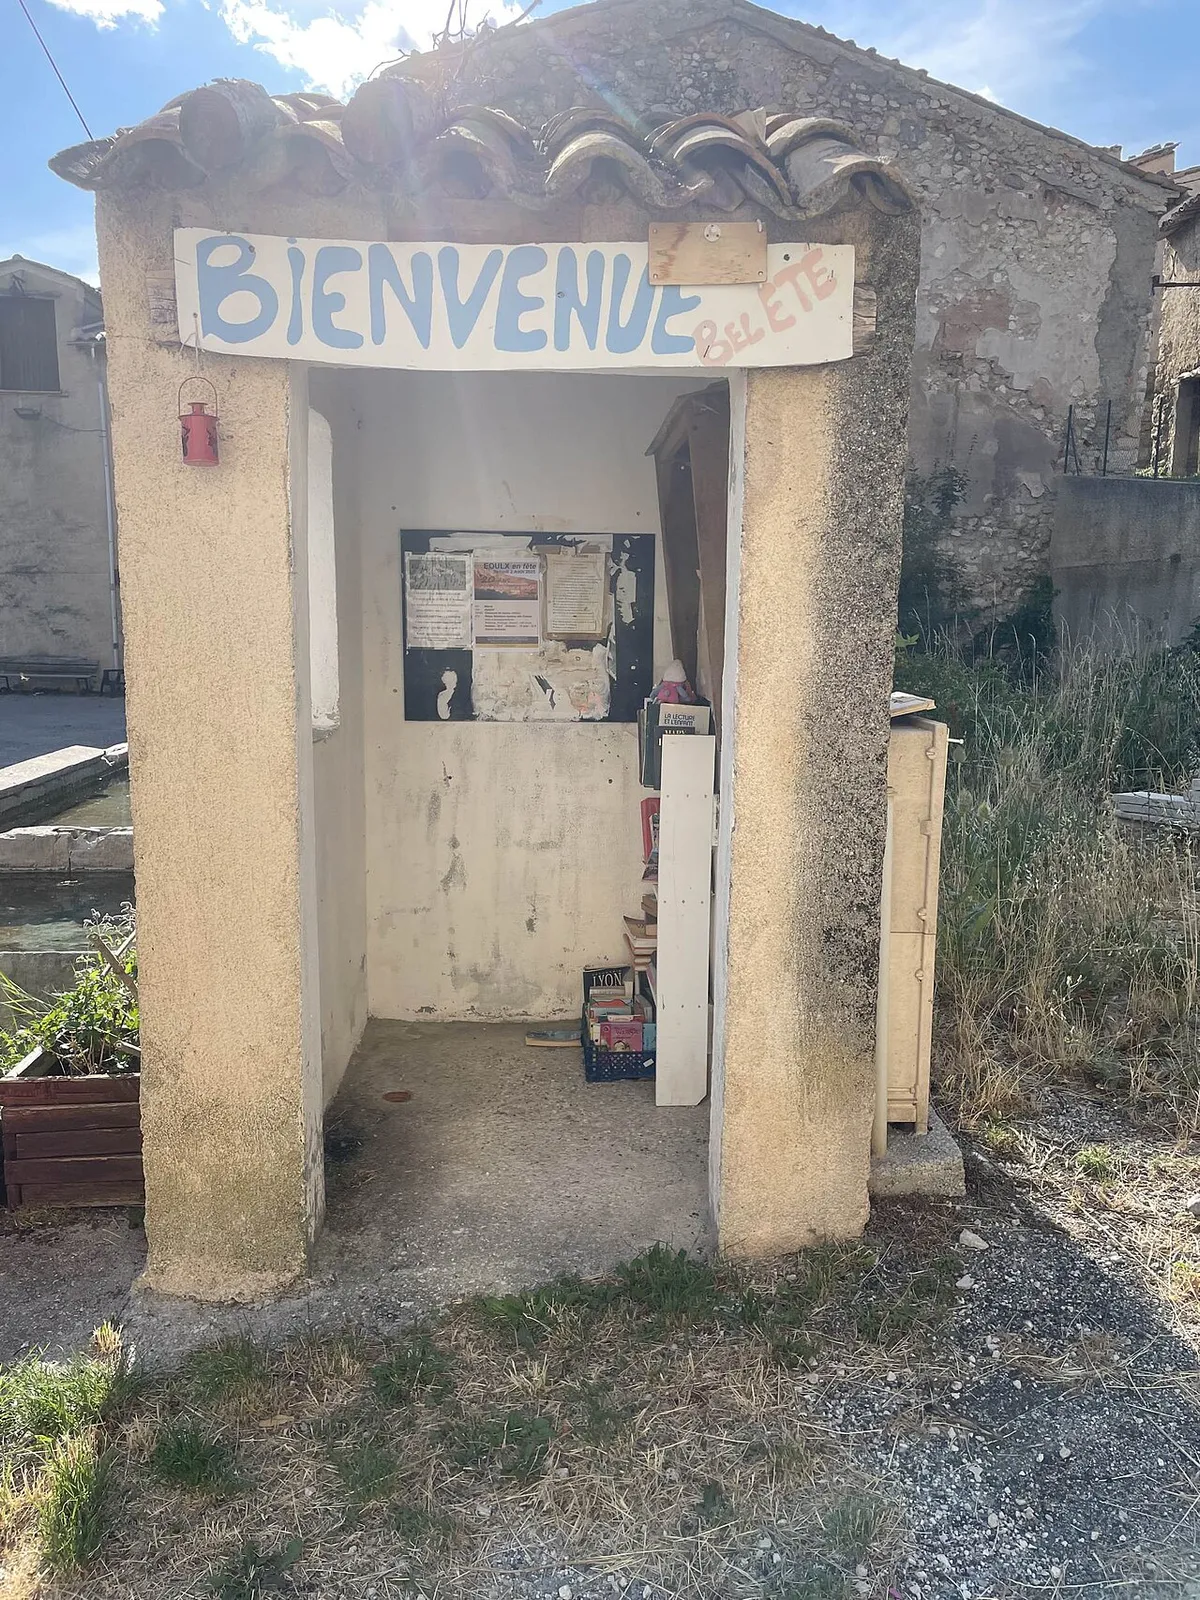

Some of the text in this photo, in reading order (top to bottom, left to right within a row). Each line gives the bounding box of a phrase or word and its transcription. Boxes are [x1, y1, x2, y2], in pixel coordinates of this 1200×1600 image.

[692, 312, 765, 366] BEL
[483, 562, 510, 570] EOULX
[522, 562, 537, 570] fête
[672, 713, 695, 722] LECTURE
[593, 972, 622, 987] LYON
